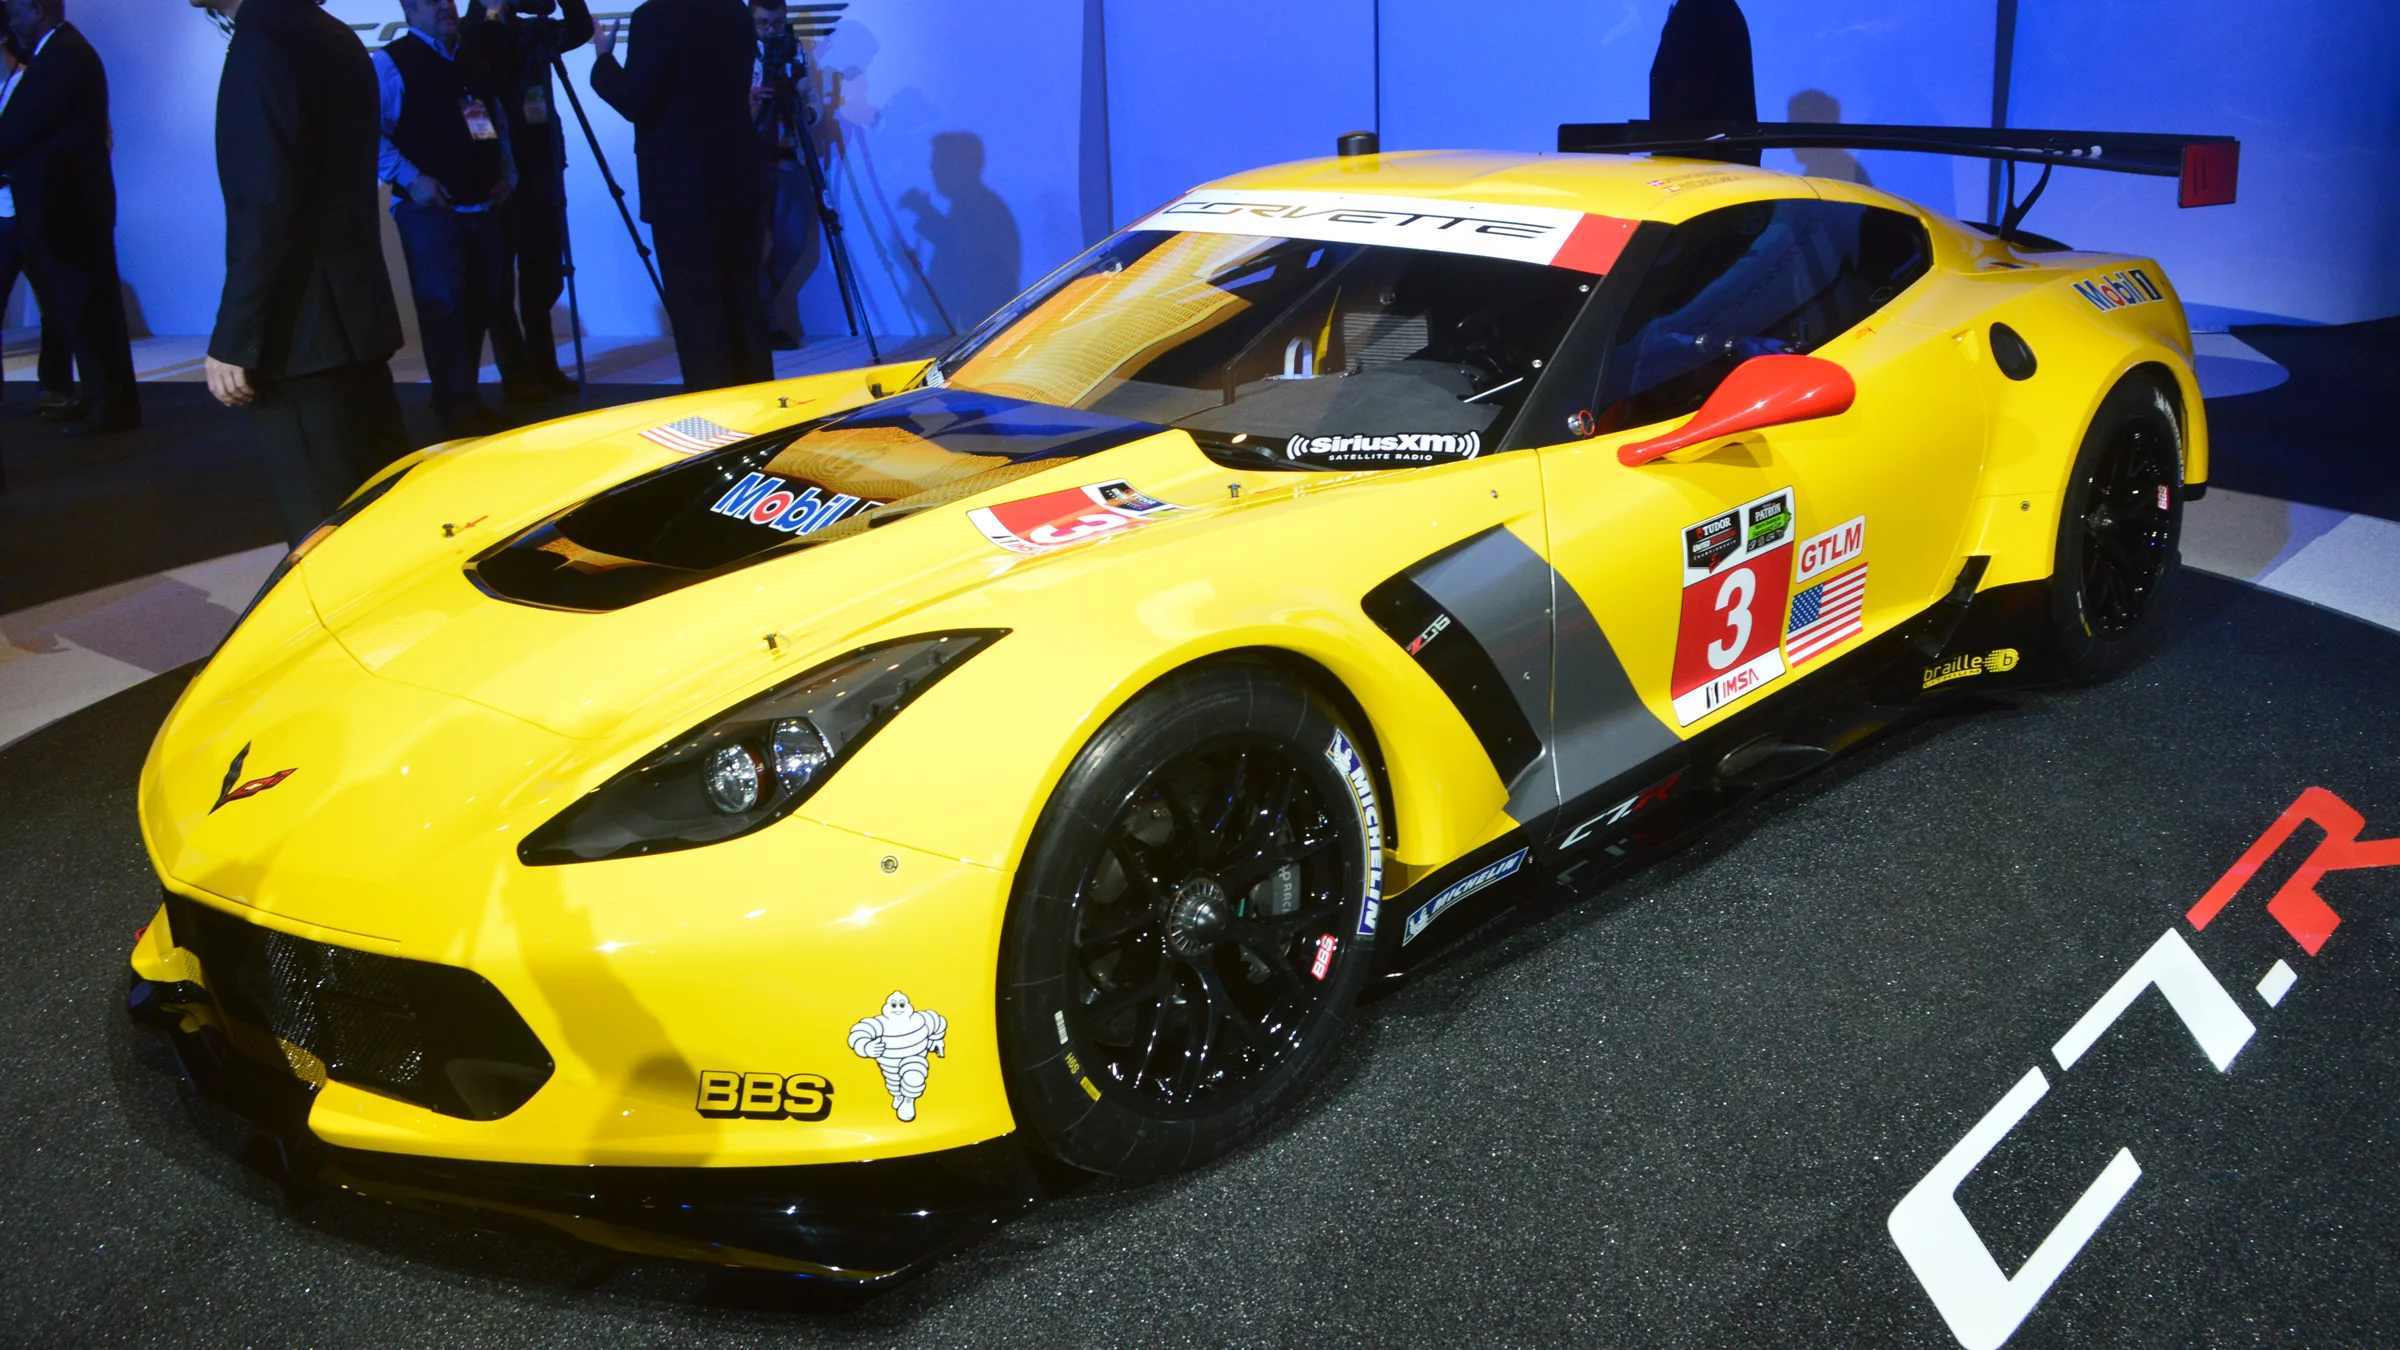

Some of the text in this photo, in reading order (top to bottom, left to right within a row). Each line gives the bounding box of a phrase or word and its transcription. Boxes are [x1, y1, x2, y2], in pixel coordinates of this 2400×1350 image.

[1161, 200, 1560, 239] CORVETTE
[2070, 270, 2148, 312] Mobil
[1329, 453, 1433, 461] SATELLITE RADIO
[710, 471, 861, 536] Mobil
[1703, 517, 1731, 536] TUDOR
[1801, 523, 1862, 574] GTLM
[1706, 567, 1757, 671] 3
[1722, 667, 1760, 699] IMSA
[1923, 654, 1983, 682] braille
[1348, 767, 1383, 930] MICHELIN
[1430, 855, 1520, 914] MICHELIN
[1311, 934, 1334, 978] BBS
[696, 1070, 834, 1122] BBS
